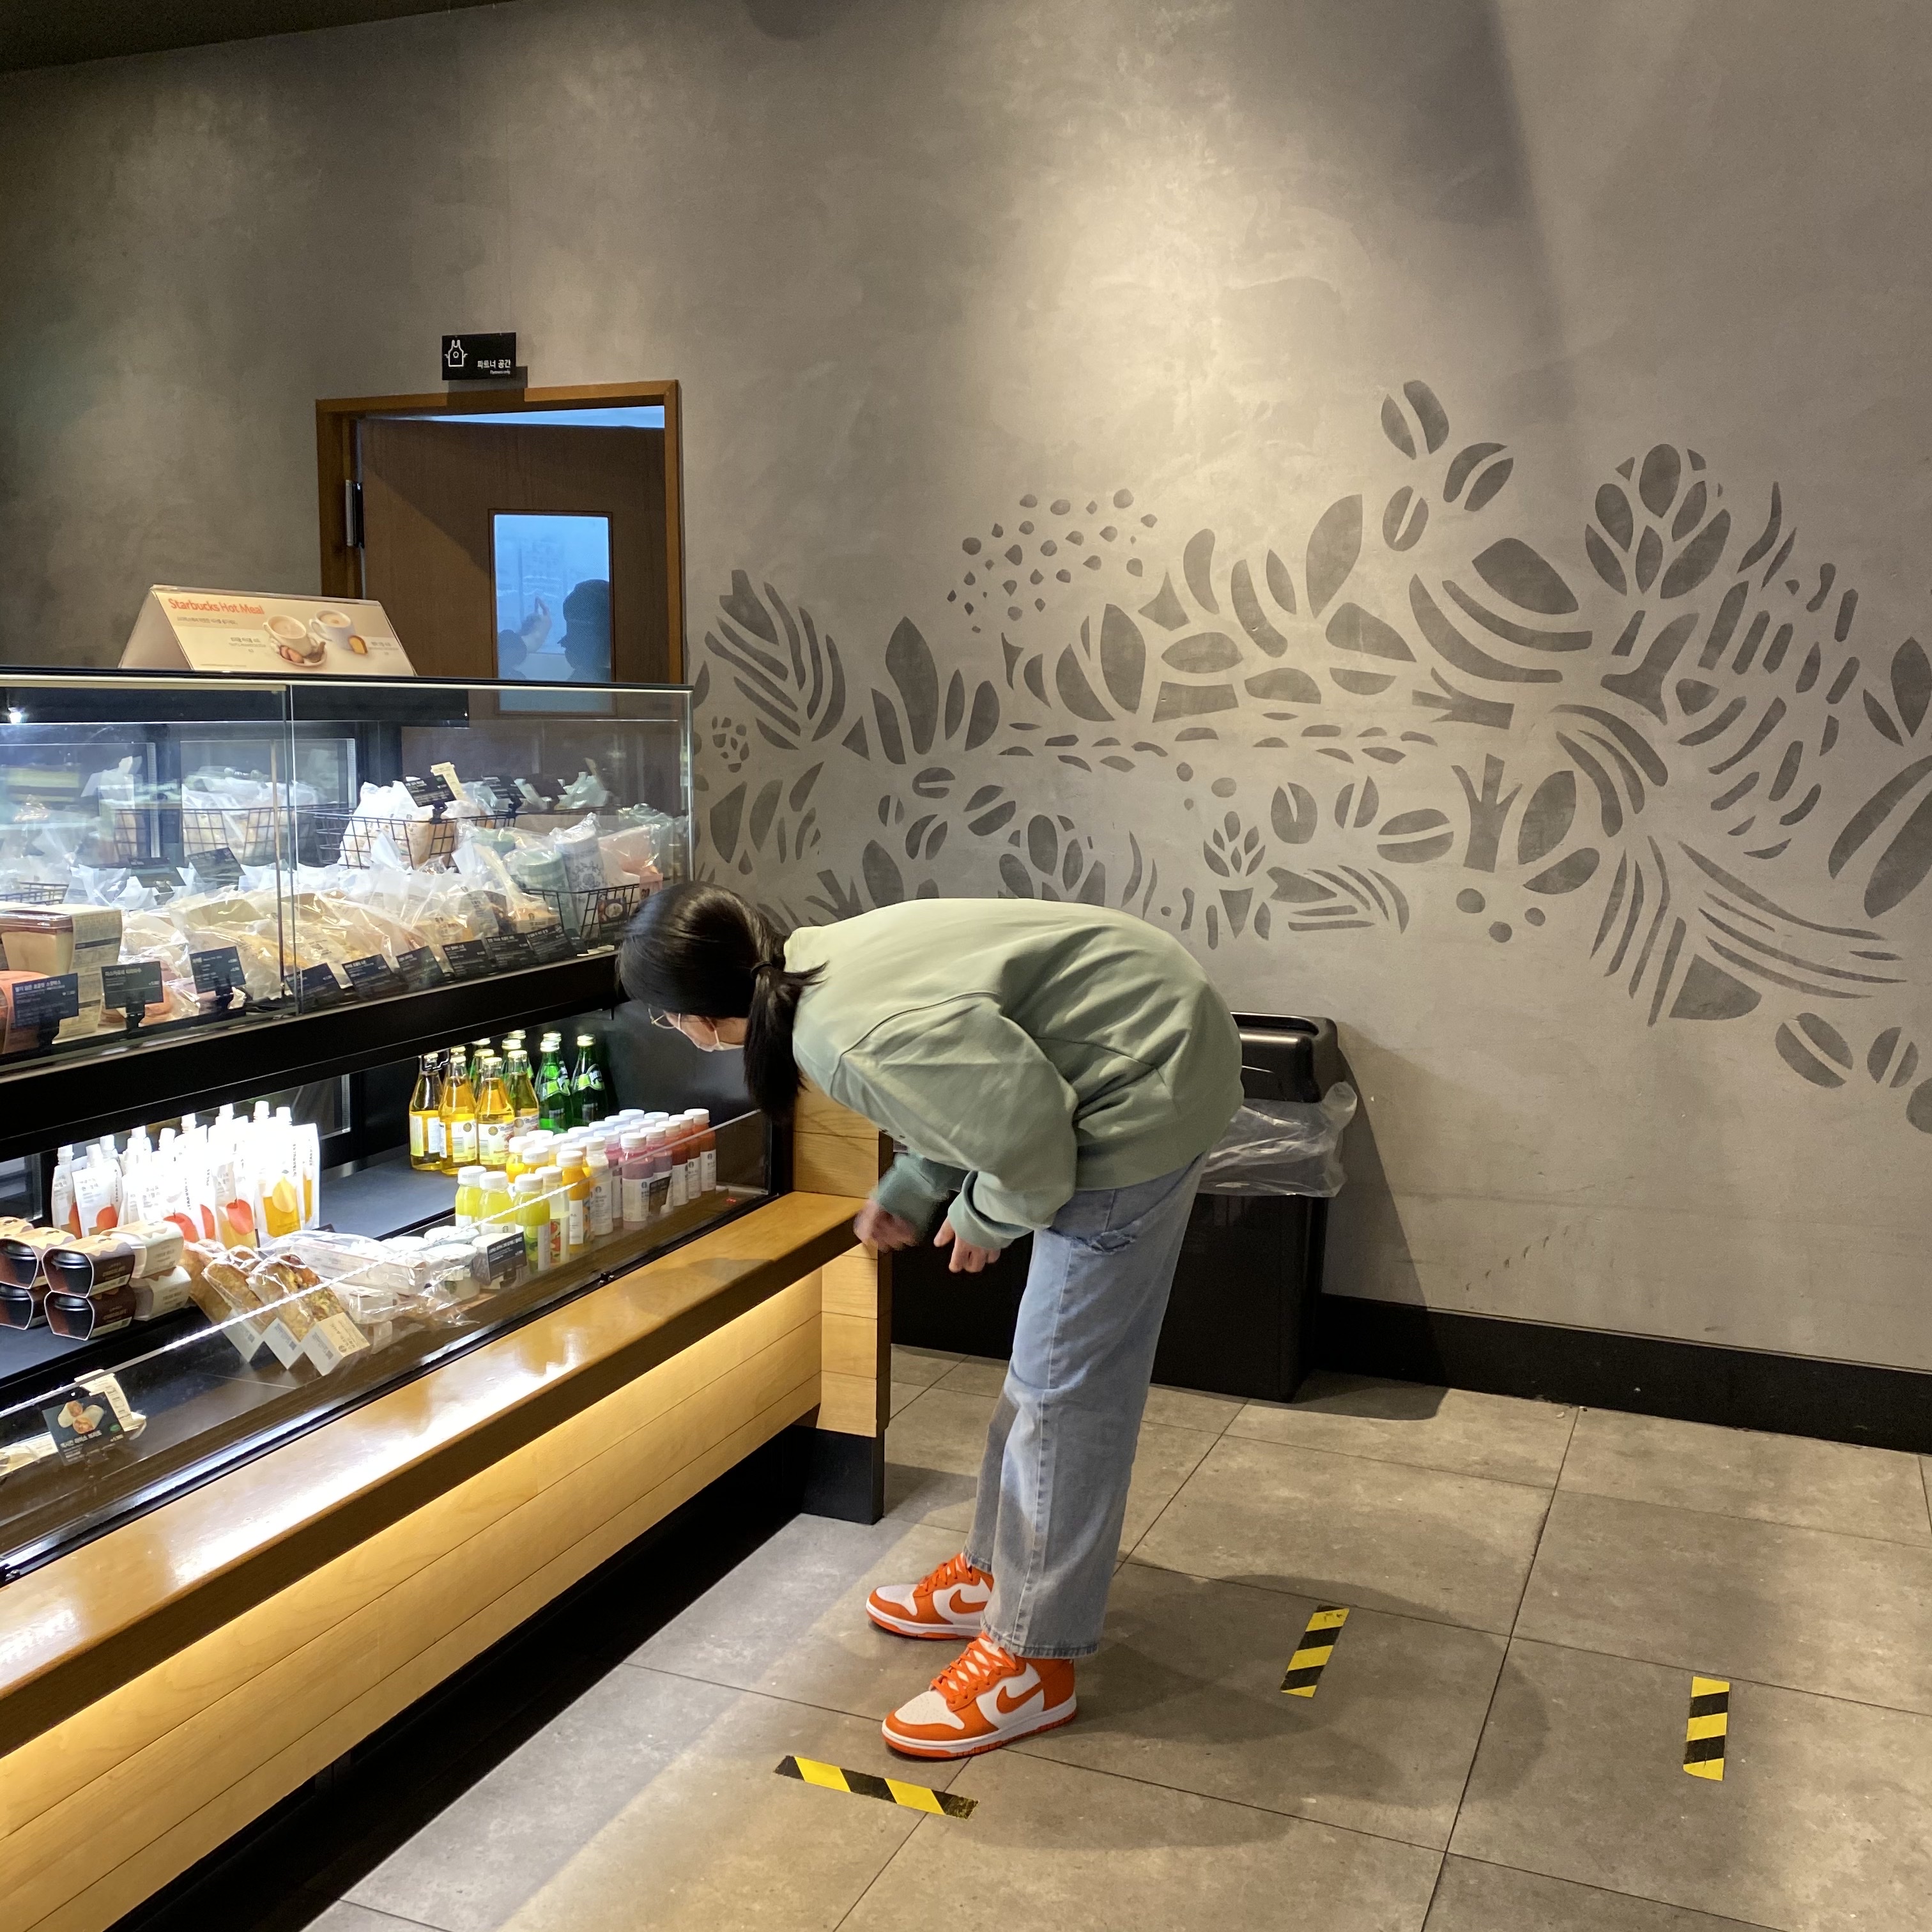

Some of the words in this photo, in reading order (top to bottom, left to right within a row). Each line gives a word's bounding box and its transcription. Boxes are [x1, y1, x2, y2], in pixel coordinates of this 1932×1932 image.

[477, 360, 496, 369] 파트너
[498, 359, 511, 369] 공간
[168, 598, 220, 612] Starbucks
[219, 602, 240, 613] Hot
[239, 603, 264, 615] Meal
